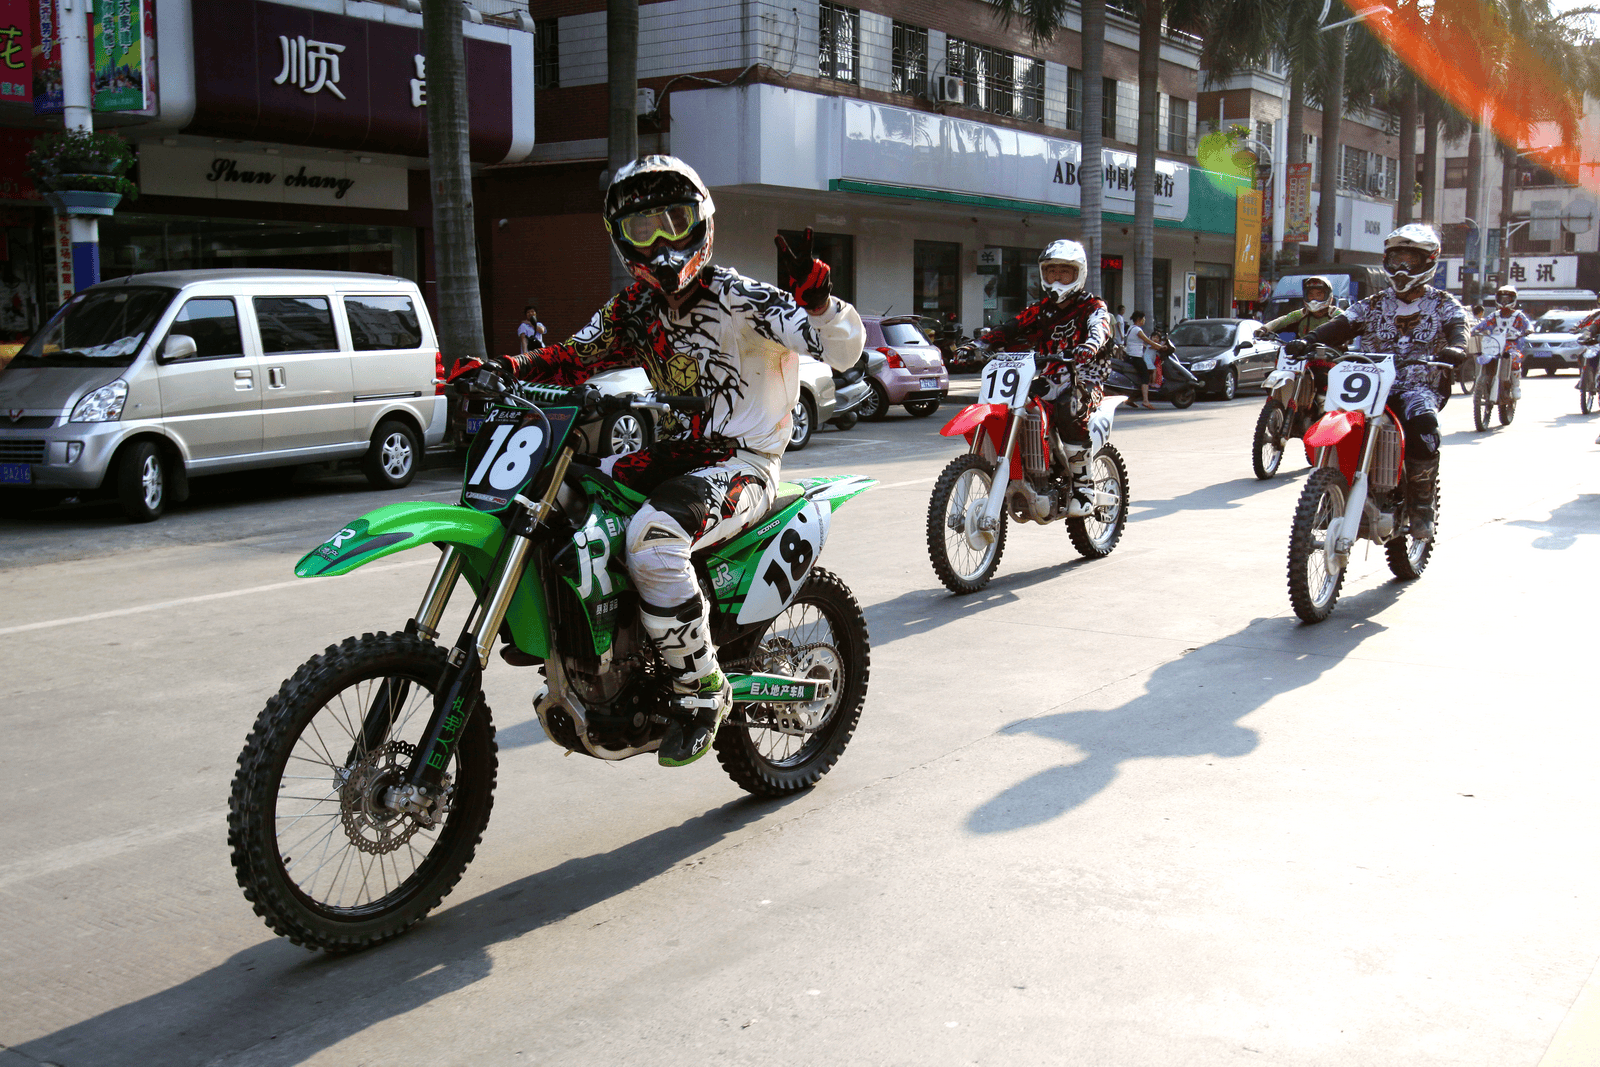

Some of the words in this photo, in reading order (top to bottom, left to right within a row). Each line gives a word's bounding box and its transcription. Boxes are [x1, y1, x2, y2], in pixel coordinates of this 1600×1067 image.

[206, 158, 277, 185] Shun
[284, 166, 355, 199] chang
[1053, 160, 1082, 188] AB
[986, 368, 1020, 399] 19
[1340, 372, 1372, 404] 9
[468, 424, 543, 490] 18
[763, 528, 813, 605] 18
[750, 682, 805, 698] 巨人地产车队
[426, 695, 466, 770] 巨人地产
